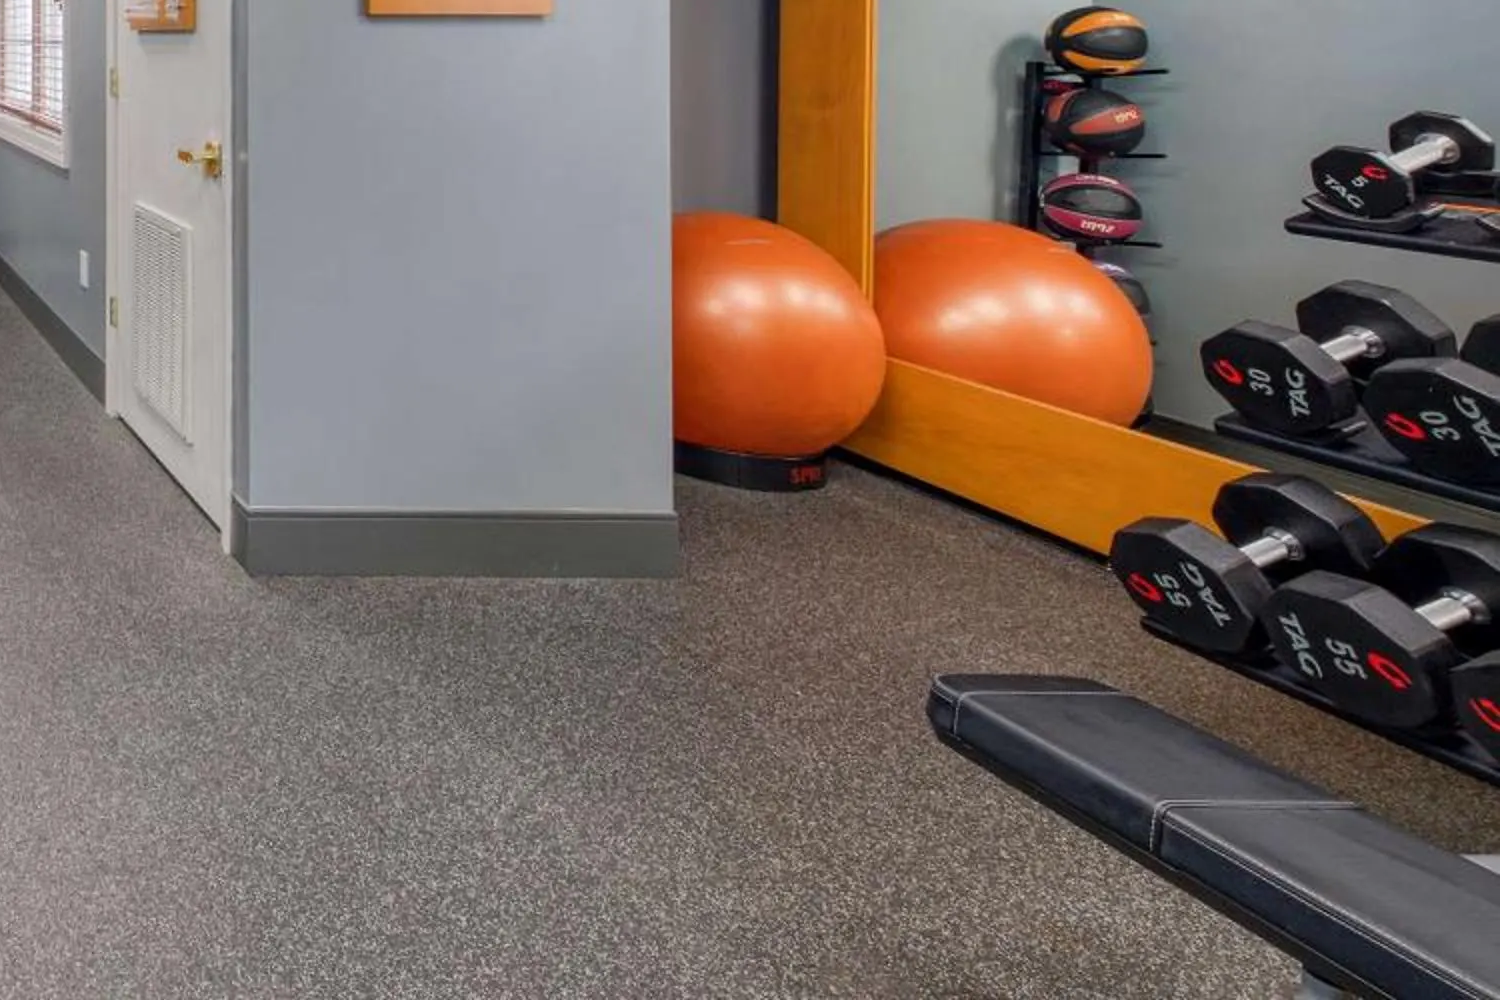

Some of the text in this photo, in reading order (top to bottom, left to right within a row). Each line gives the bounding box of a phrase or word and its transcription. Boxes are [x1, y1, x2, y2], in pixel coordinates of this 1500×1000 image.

[1324, 173, 1365, 209] TAG
[1247, 367, 1274, 396] 30
[1285, 367, 1311, 417] TAG
[1419, 410, 1461, 441] 30
[1452, 395, 1500, 457] TAG
[1152, 571, 1192, 608] 55
[1179, 561, 1232, 628] TAG
[1278, 612, 1323, 679] TAG
[1325, 637, 1368, 680] 55
